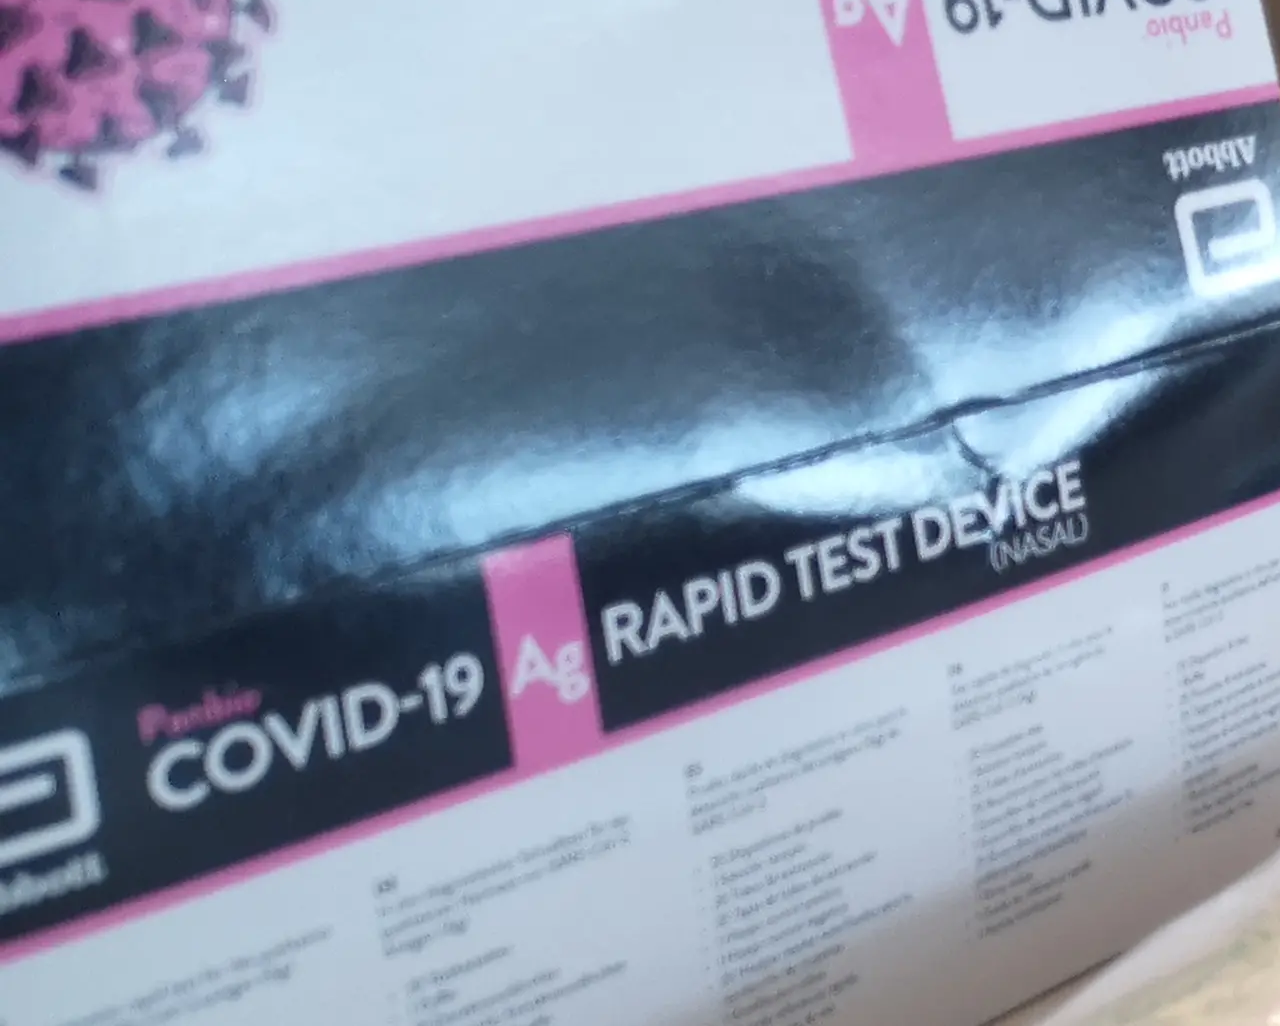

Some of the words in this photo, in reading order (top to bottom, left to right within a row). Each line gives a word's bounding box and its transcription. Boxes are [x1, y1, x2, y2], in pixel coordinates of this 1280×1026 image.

[1162, 135, 1257, 182] Abbott
[987, 514, 1091, 573] (NASAL)
[147, 653, 486, 812] COVID-19
[510, 633, 592, 705] Ag
[601, 562, 783, 665] RAPID
[785, 517, 904, 602] TEST
[910, 459, 1088, 564] DEVICE
